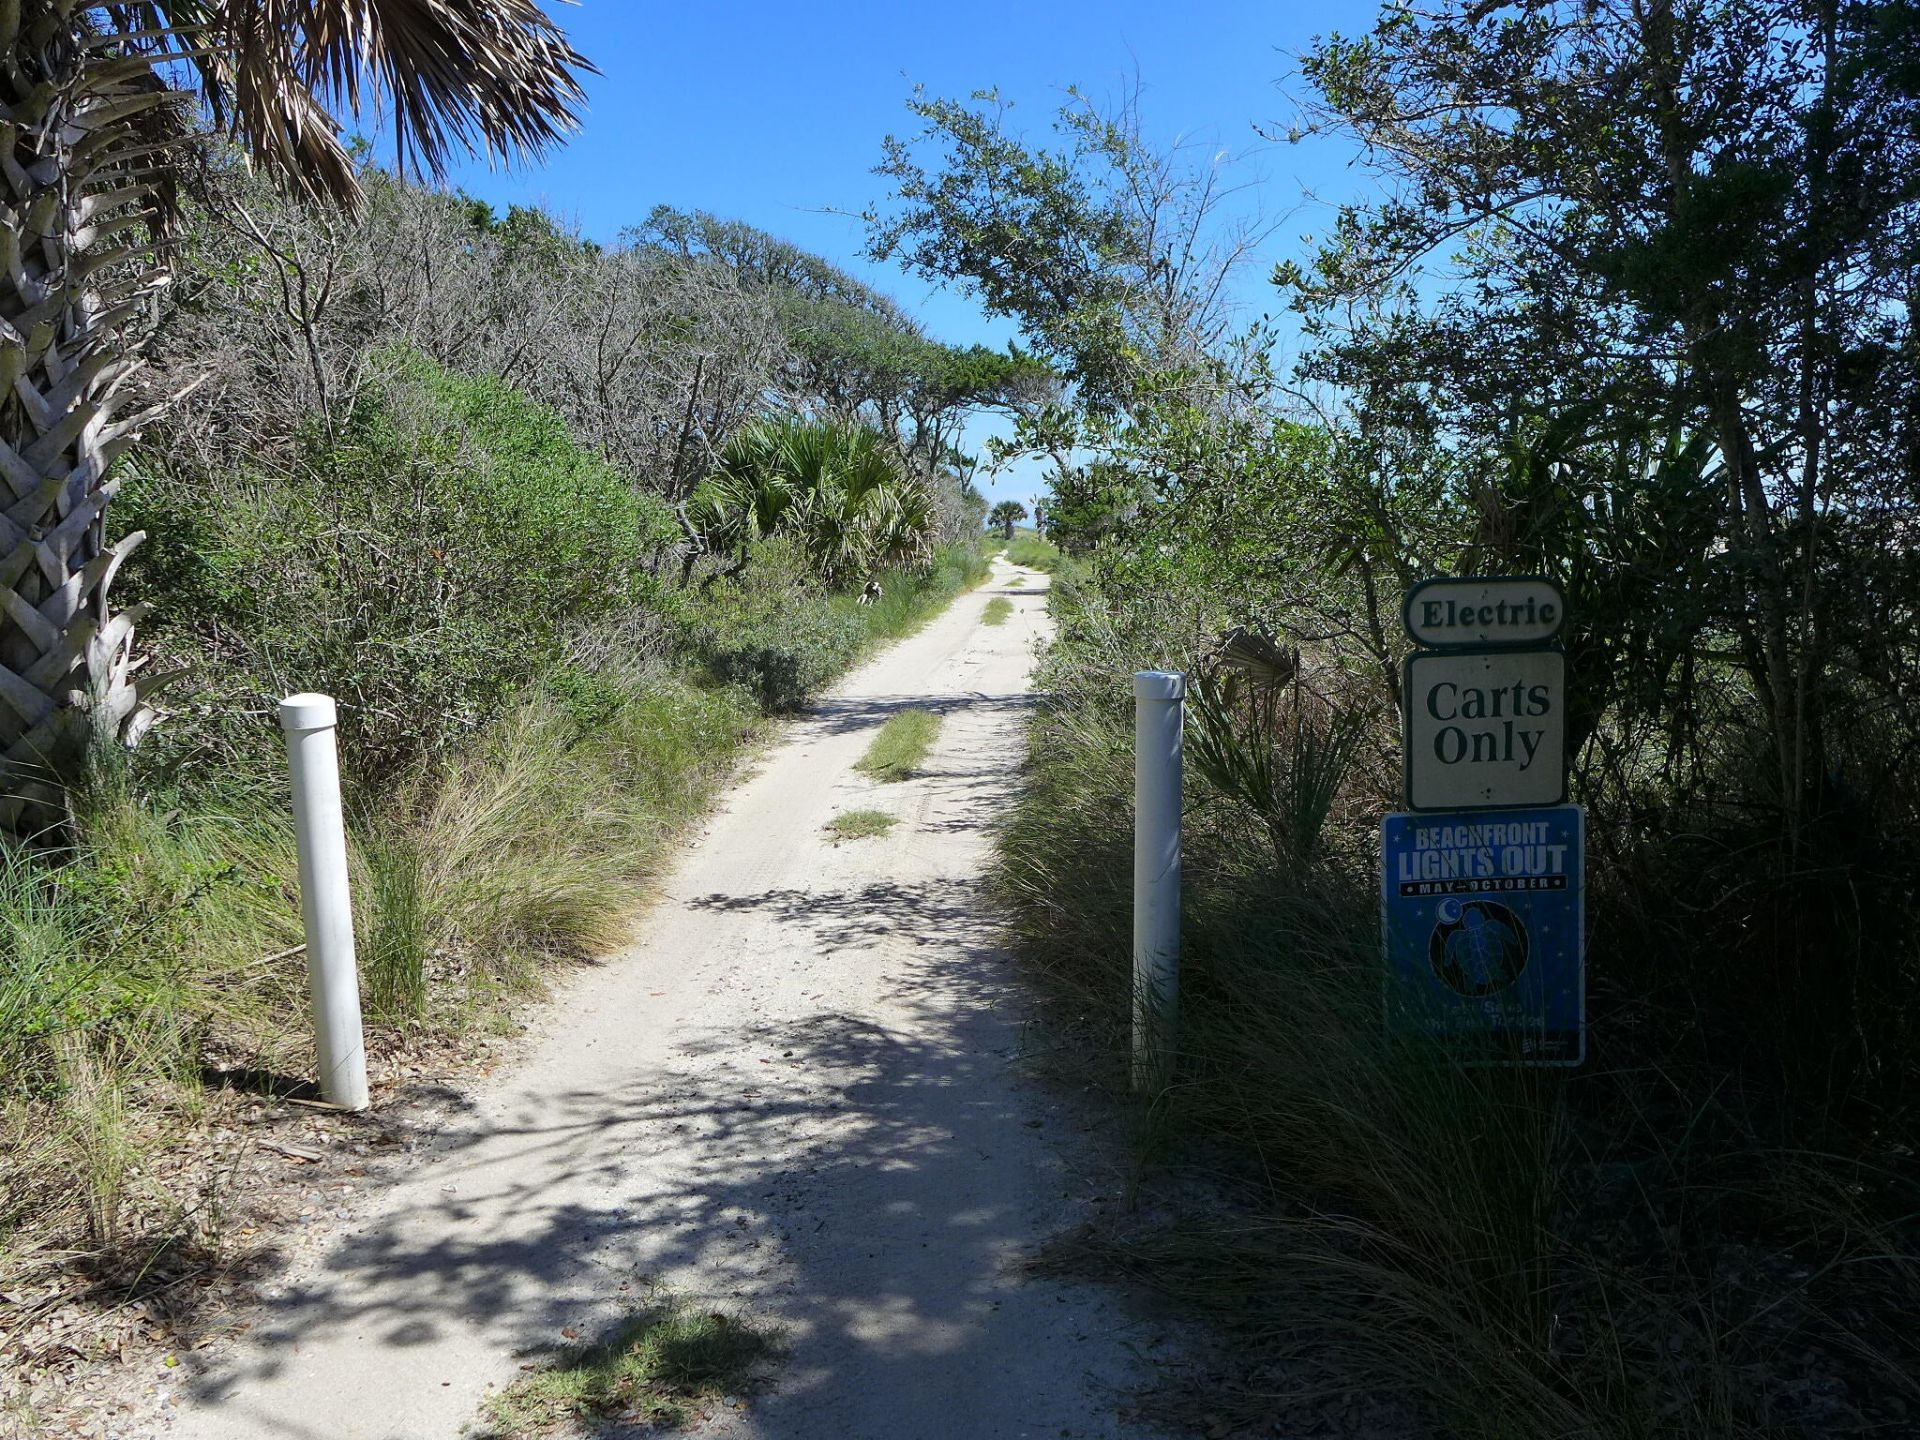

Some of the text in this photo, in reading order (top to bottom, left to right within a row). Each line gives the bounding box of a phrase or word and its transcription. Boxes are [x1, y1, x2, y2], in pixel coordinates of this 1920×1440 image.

[1421, 596, 1555, 627] Electric
[1427, 678, 1551, 721] Carts
[1433, 720, 1545, 771] Only
[1415, 822, 1549, 850] BEACHFRONT
[1399, 844, 1568, 881] LIGHTS OUT
